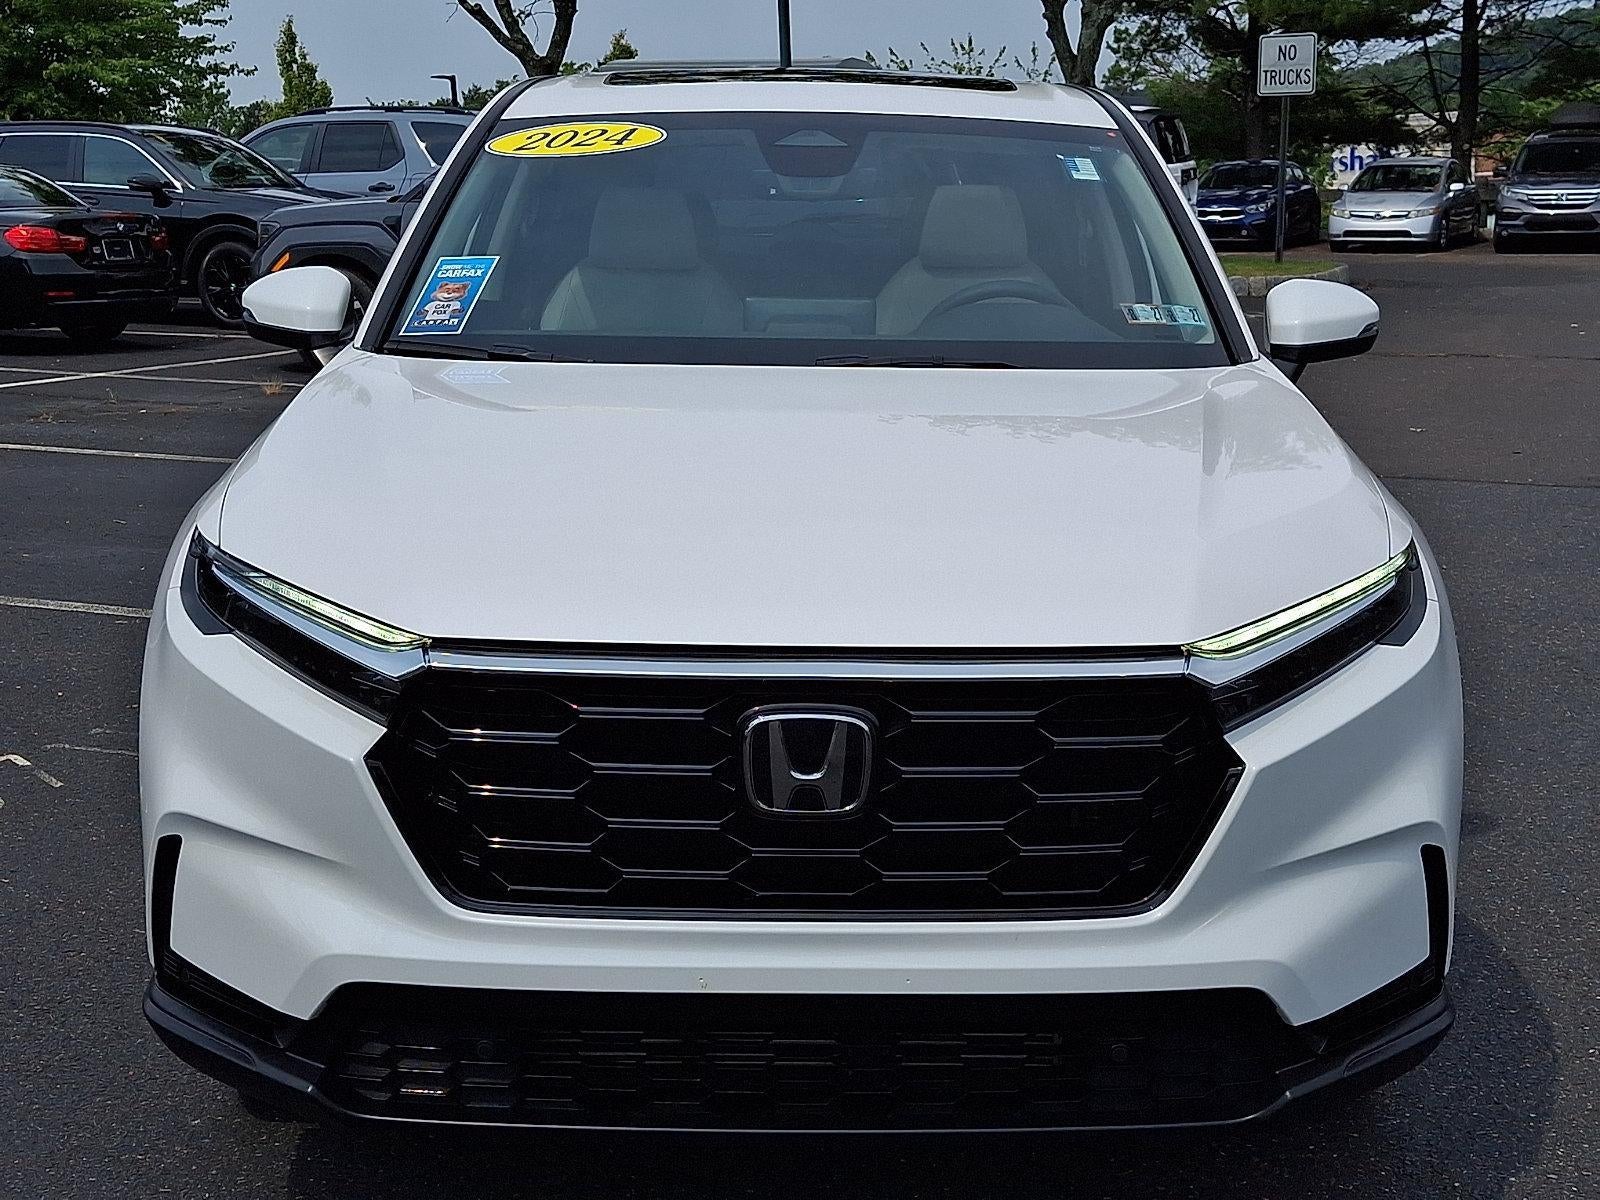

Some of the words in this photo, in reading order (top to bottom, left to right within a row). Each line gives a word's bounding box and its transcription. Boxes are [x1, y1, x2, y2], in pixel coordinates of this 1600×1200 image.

[1277, 44, 1298, 62] NO
[1262, 68, 1312, 86] TRUCKS
[512, 127, 640, 152] 2024
[437, 269, 485, 278] CARFAX
